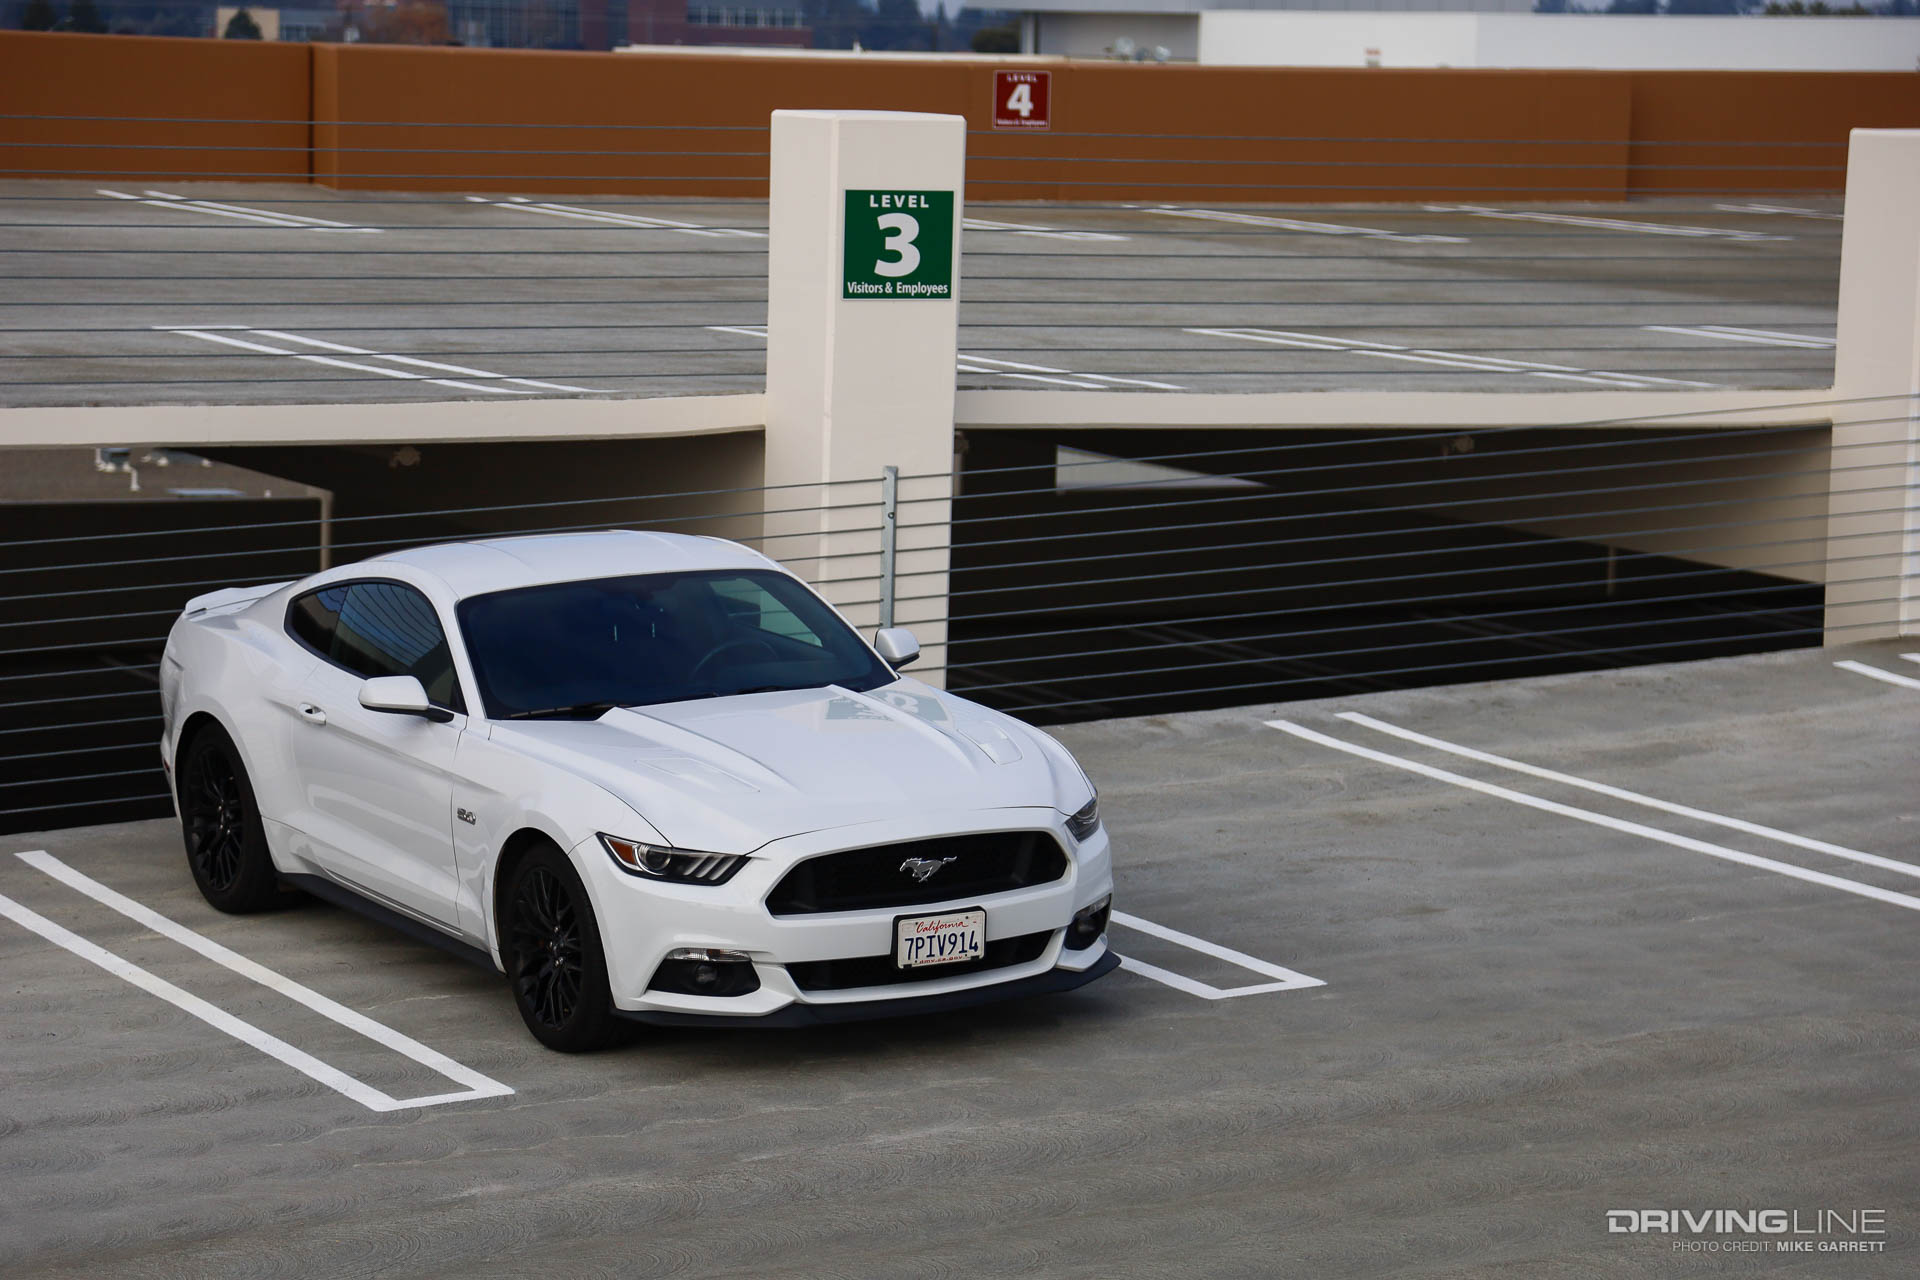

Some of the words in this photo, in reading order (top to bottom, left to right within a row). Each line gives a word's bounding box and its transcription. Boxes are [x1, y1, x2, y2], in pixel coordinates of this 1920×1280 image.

[1007, 83, 1034, 117] 4
[869, 194, 930, 208] LEVEL
[874, 212, 921, 277] 3
[847, 281, 883, 294] Visitors
[885, 281, 893, 294] &
[896, 281, 948, 296] Employees
[916, 919, 969, 934] California
[904, 930, 979, 960] 7PIV914
